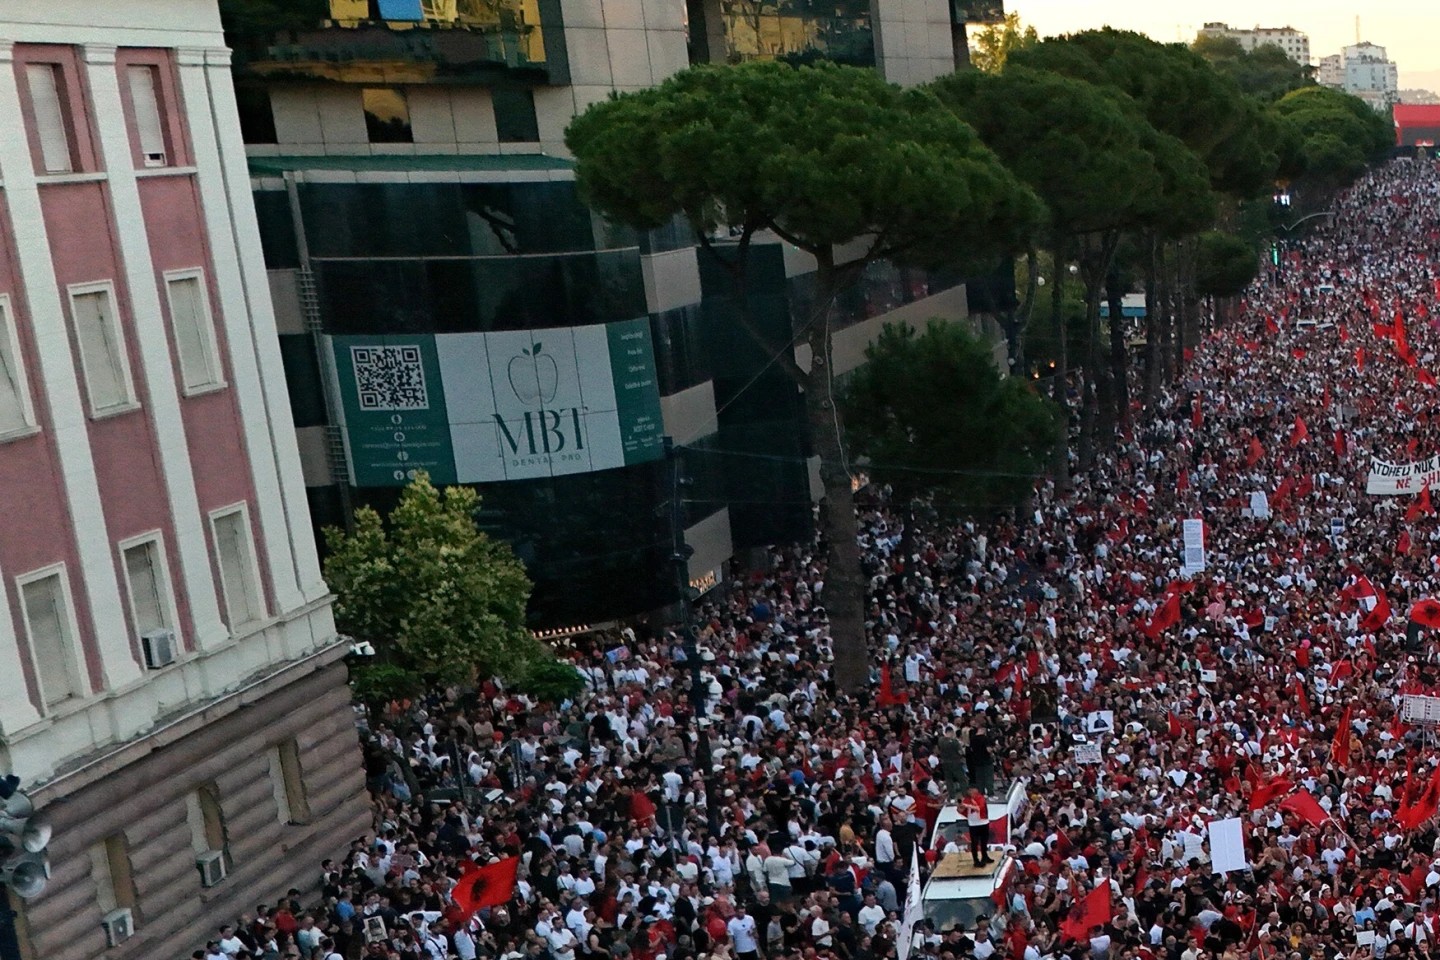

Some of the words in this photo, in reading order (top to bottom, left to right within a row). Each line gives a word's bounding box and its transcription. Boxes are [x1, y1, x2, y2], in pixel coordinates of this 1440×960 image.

[491, 406, 588, 457] MBT
[513, 456, 554, 467] DENTAL
[561, 452, 583, 462] PRO
[1414, 459, 1435, 474] NUK
